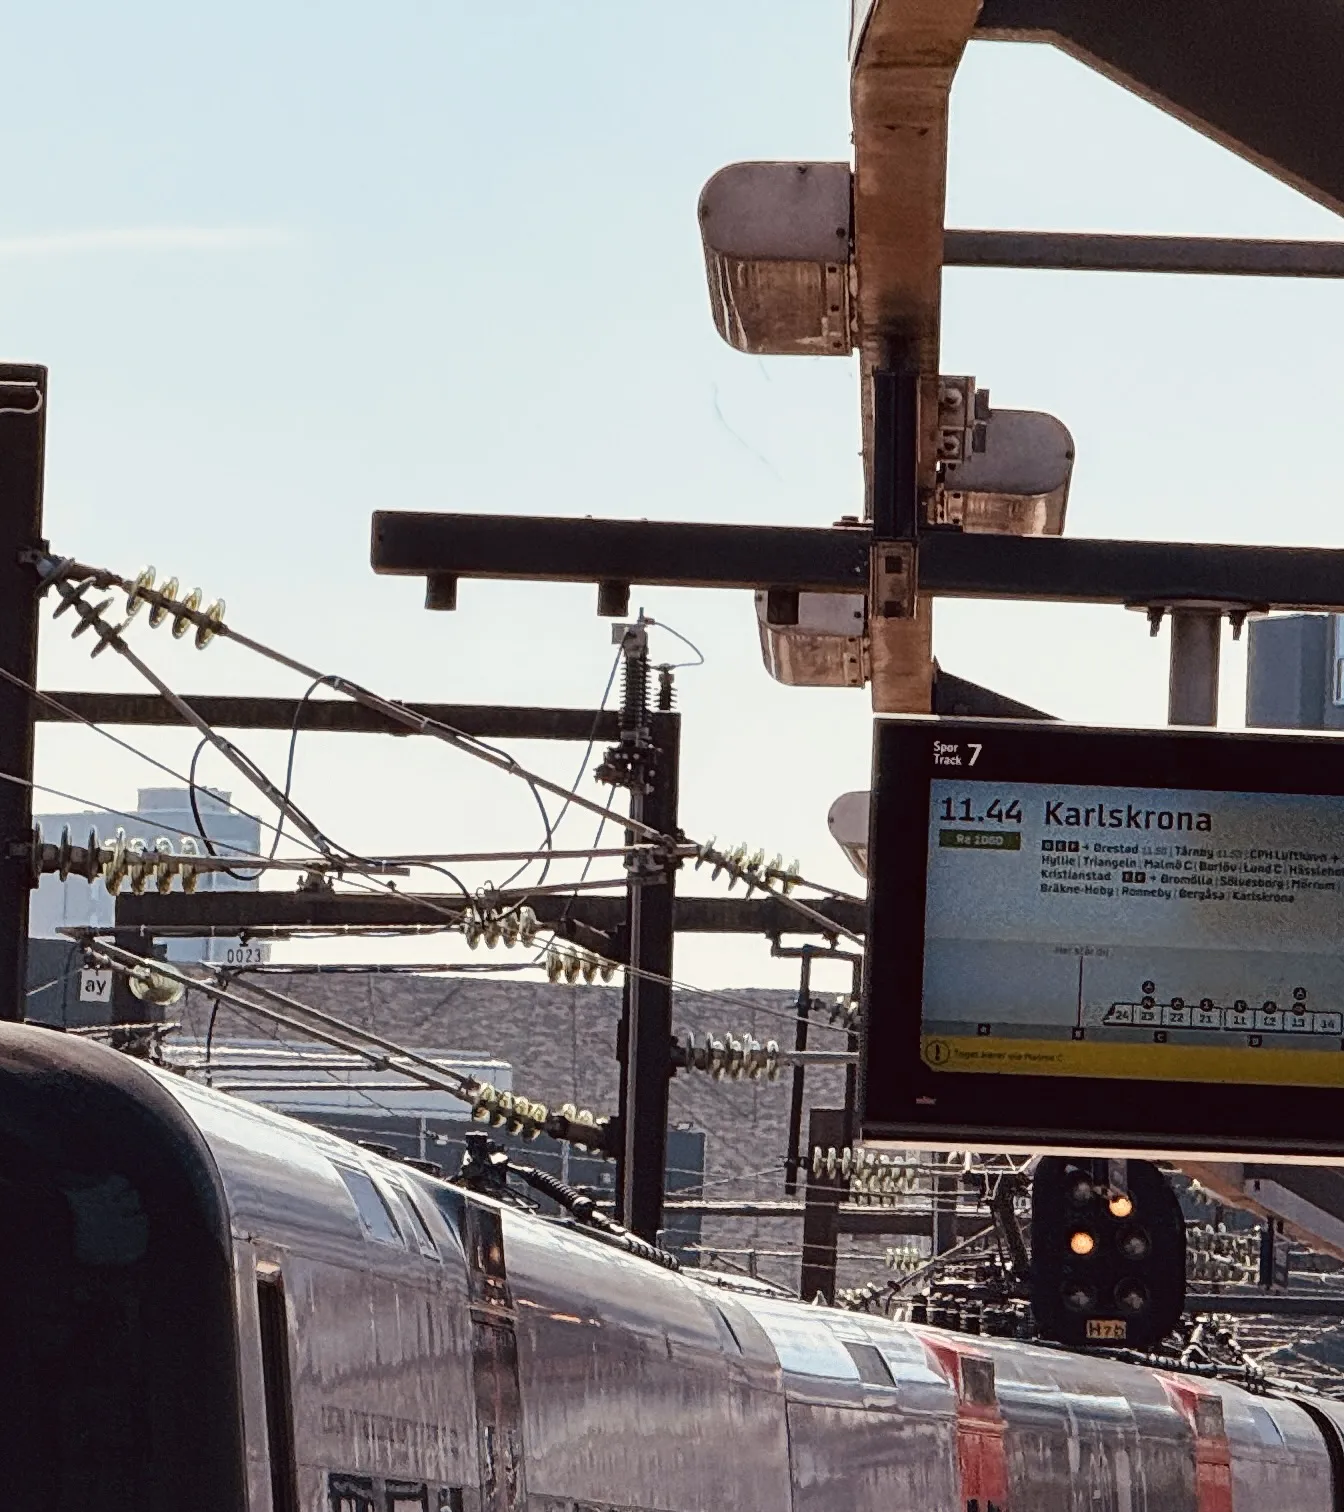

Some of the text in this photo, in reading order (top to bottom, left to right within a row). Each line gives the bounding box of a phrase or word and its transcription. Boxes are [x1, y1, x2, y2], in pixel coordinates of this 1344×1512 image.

[933, 740, 982, 766] Spor 7
[933, 753, 962, 766] Track
[940, 797, 1212, 832] 11.44 Karlskrona
[1093, 843, 1139, 854] Ørestad
[1174, 845, 1214, 859] Tårnby
[1249, 850, 1273, 860] CPH
[1275, 850, 1328, 863] Lufthavn
[1041, 856, 1075, 868] Hyllie
[1082, 857, 1137, 869] Triangeln
[1143, 858, 1183, 869] Malmö
[1184, 861, 1193, 870] C
[1244, 864, 1272, 875] Lund
[1273, 865, 1283, 874] C
[1041, 869, 1112, 881] Kristianstad
[1160, 875, 1213, 886] Bromölla
[1220, 876, 1284, 890] Sölvesborg
[1291, 879, 1336, 890] Mörrum
[1040, 883, 1295, 903] Bräkne-Hoby Ronneby Bergåsa Karlskrona
[227, 949, 262, 963] 0023
[85, 979, 107, 996] ay
[1116, 1010, 1129, 1020] 24
[1170, 1012, 1184, 1022] 22
[1199, 1013, 1212, 1023] 21
[1233, 1015, 1246, 1025] 11
[1263, 1016, 1277, 1027] 12
